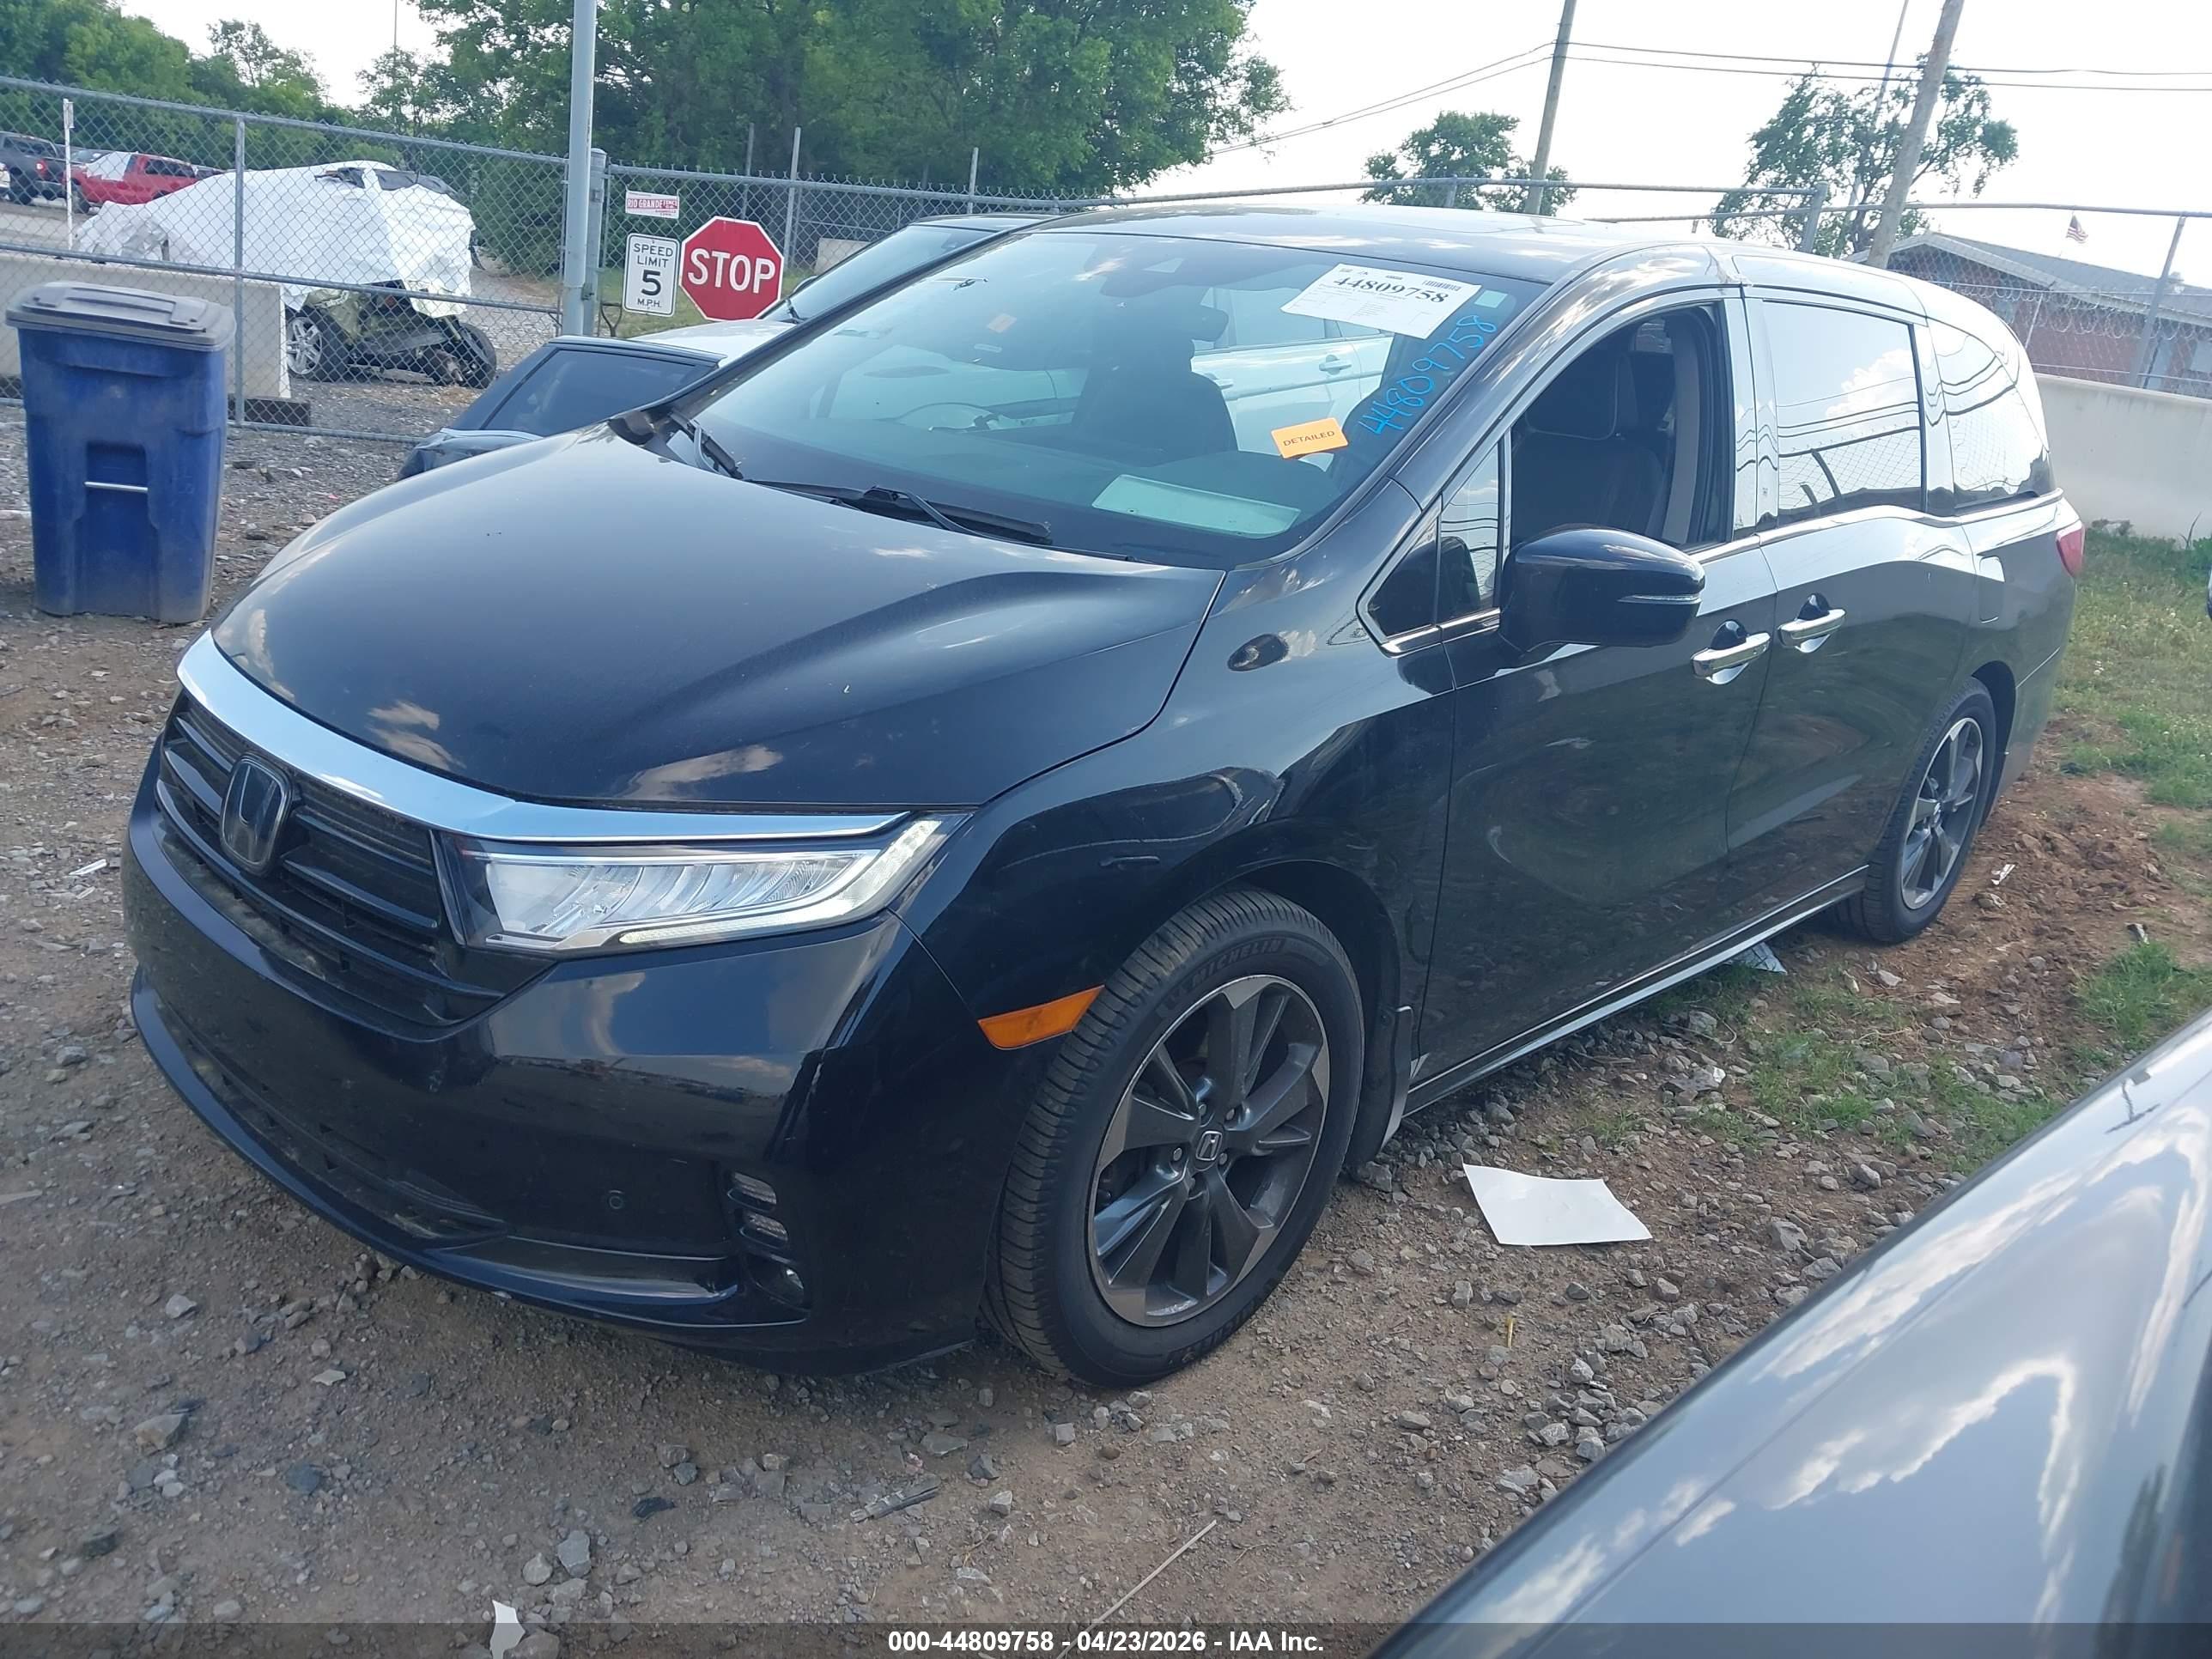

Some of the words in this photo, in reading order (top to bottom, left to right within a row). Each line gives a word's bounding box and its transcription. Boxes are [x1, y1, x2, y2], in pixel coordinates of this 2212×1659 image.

[628, 199, 638, 208] RIO
[639, 199, 663, 209] GRANDE
[634, 243, 673, 257] SPEED
[637, 255, 669, 268] LIMIT
[688, 248, 775, 294] STOP
[641, 269, 661, 296] 5
[1333, 276, 1449, 302] 44809758
[637, 298, 662, 307] M.P.H.
[1358, 314, 1497, 434] 44809758
[1283, 430, 1334, 446] DETAILED
[1193, 939, 1286, 987] MICHELIN
